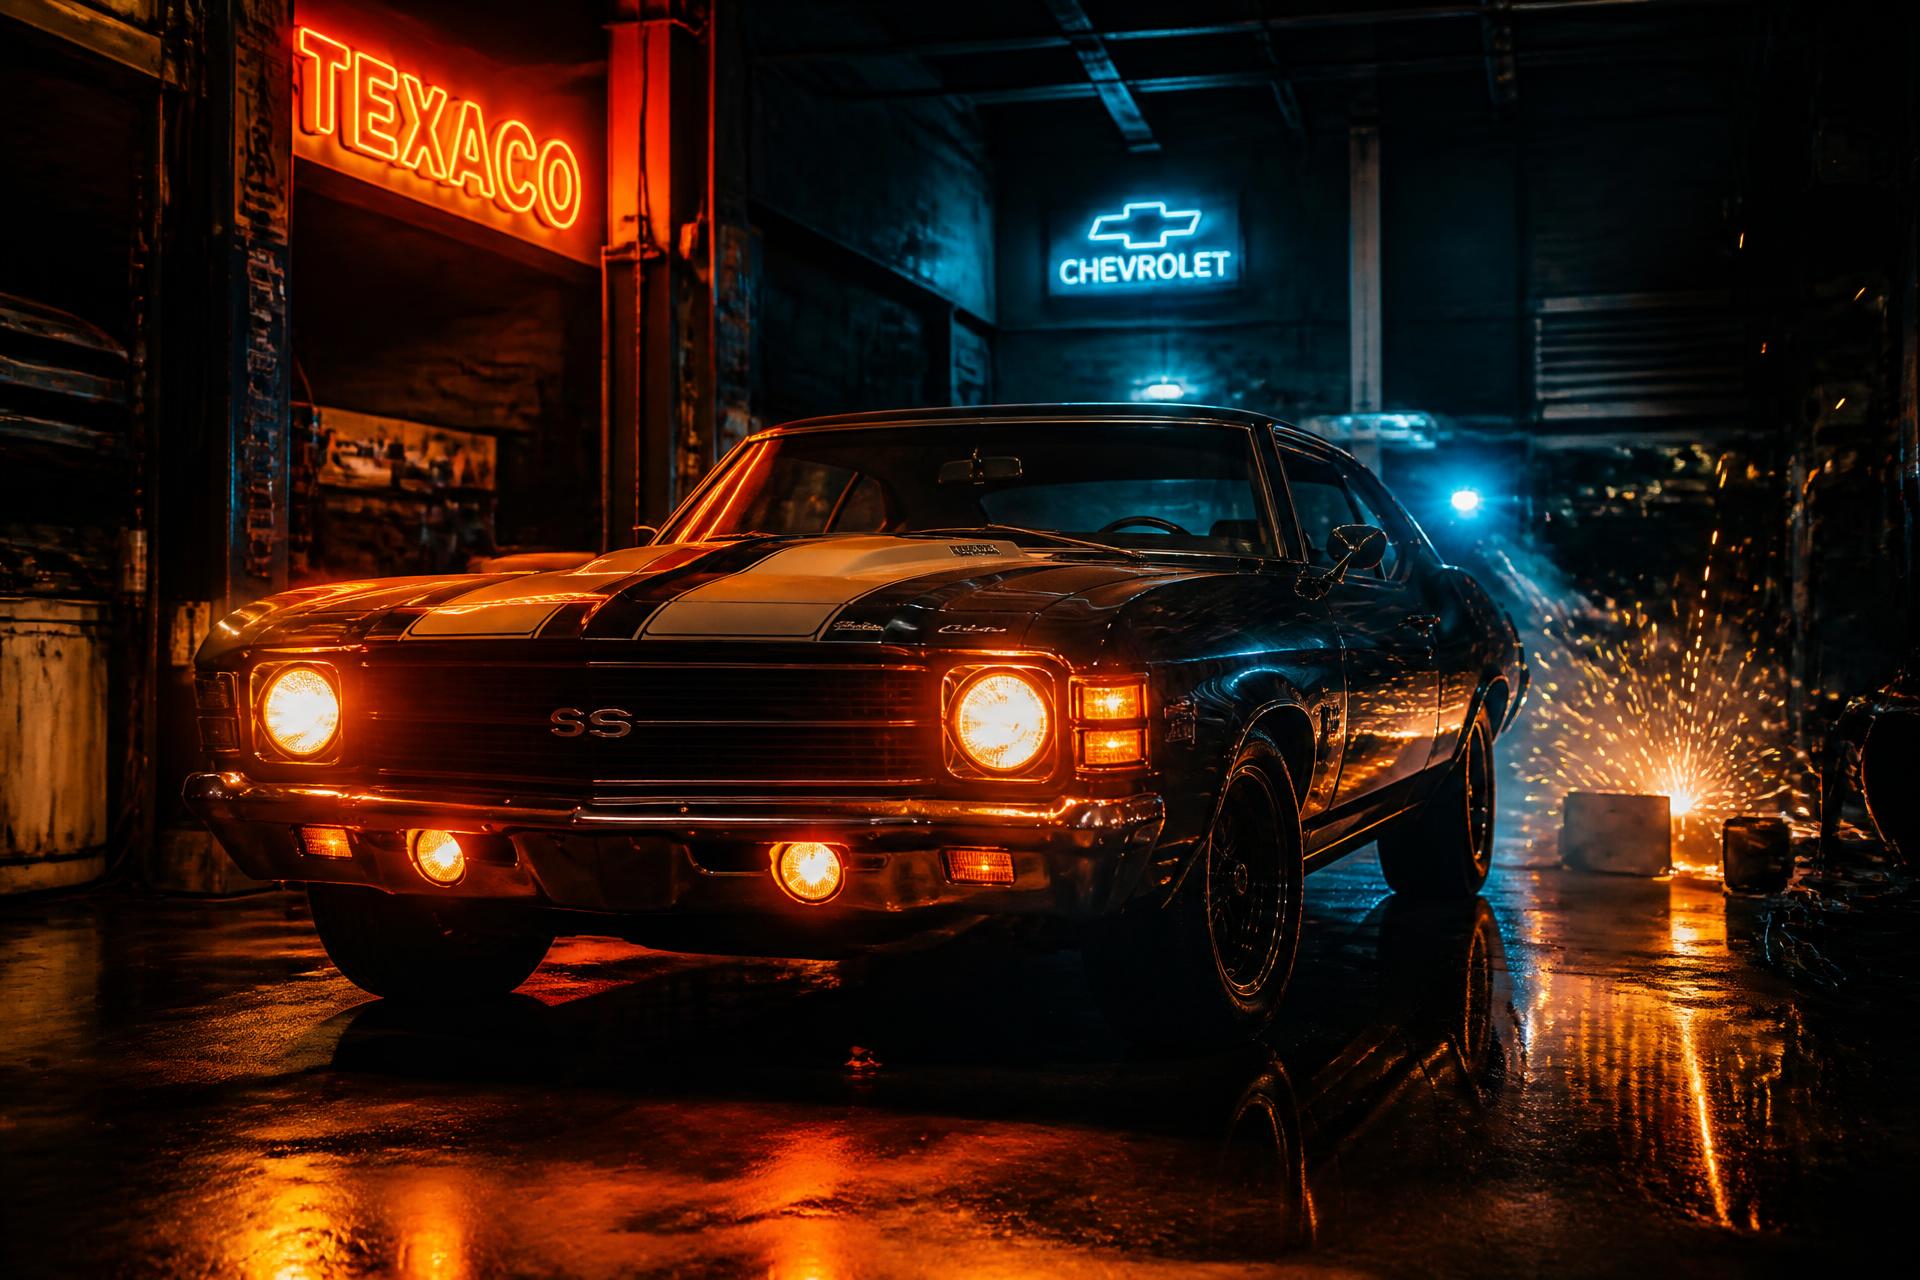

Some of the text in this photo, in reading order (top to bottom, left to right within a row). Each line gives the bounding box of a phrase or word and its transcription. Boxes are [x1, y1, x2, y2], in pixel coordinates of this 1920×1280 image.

[300, 27, 582, 229] TEXACO
[1059, 250, 1231, 285] CHEVROLET
[550, 707, 633, 737] SS
